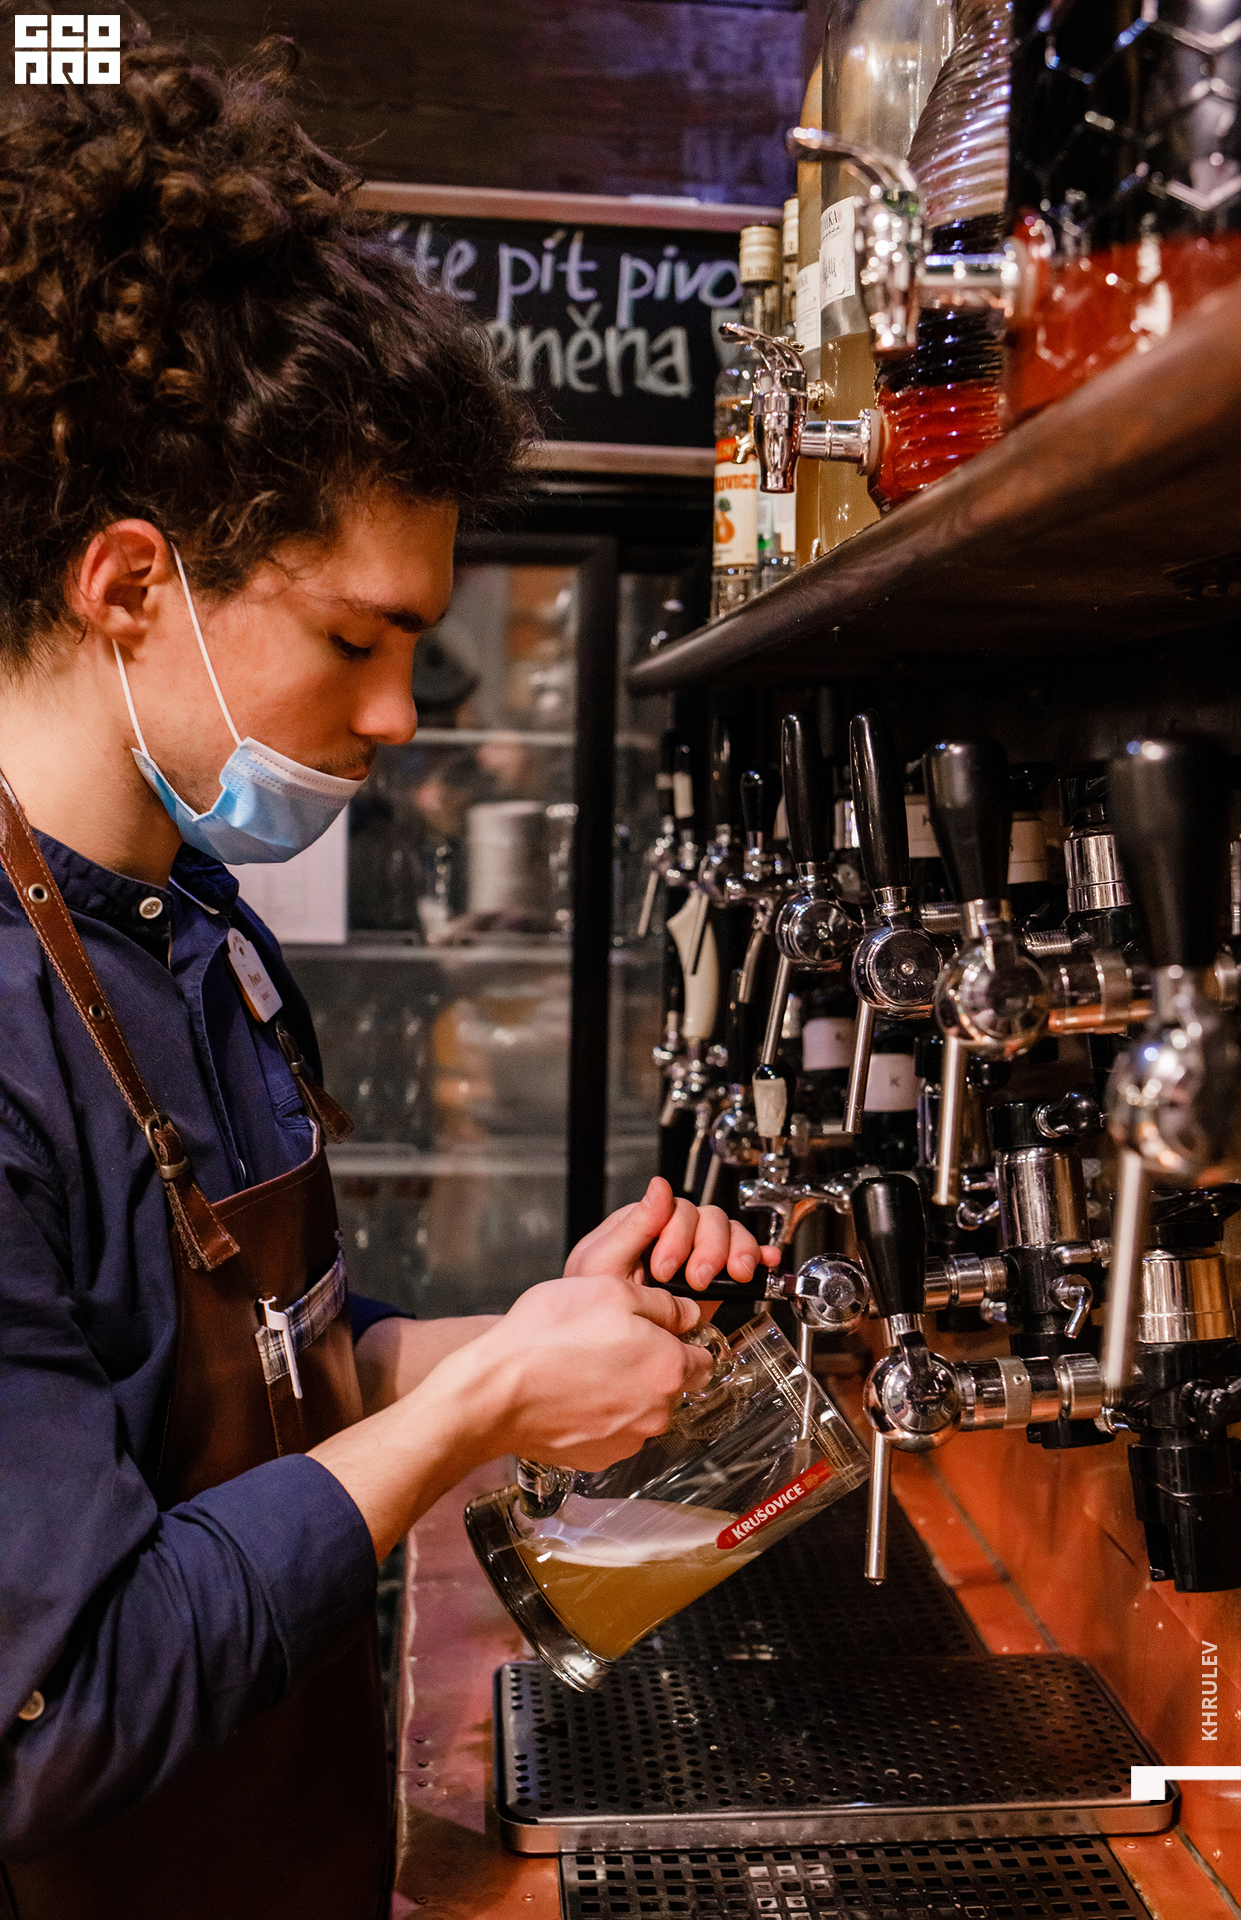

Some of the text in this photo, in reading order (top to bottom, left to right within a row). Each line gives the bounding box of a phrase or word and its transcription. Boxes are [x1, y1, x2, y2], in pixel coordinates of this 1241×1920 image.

[499, 230, 597, 324] pít
[615, 244, 743, 329] pivo
[714, 473, 758, 492] OVICE
[731, 1483, 805, 1540] KRUŠOVICE
